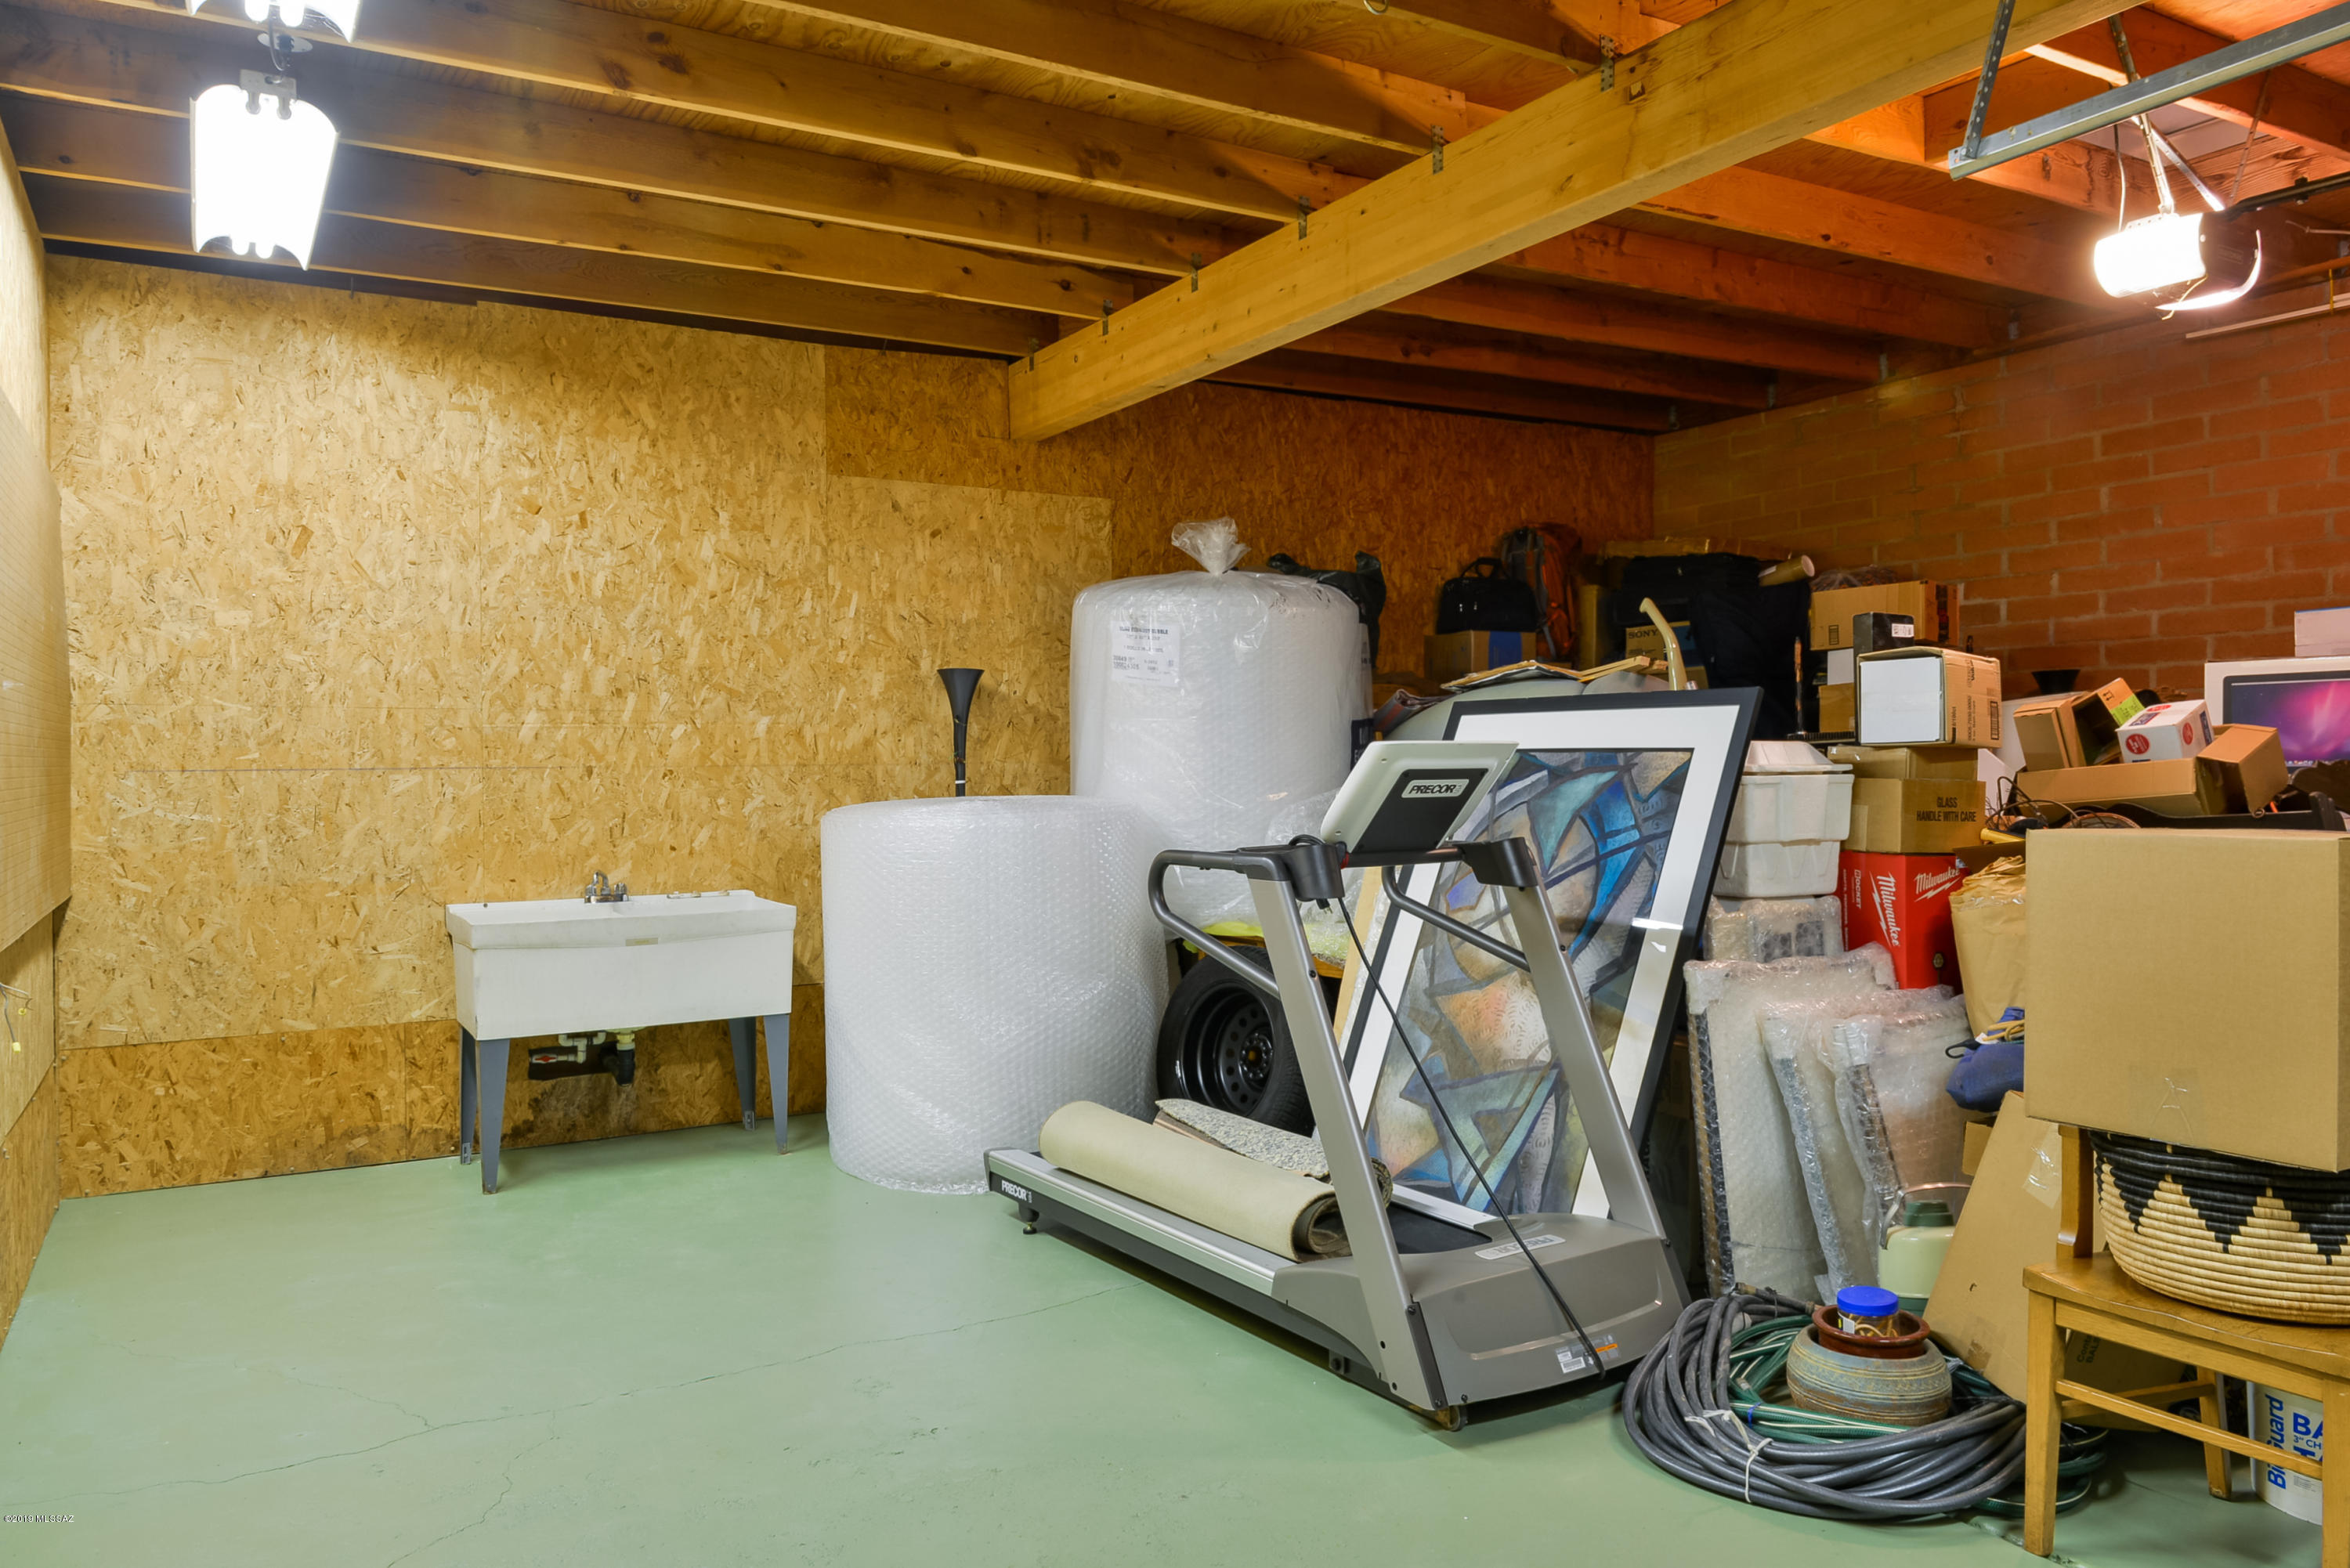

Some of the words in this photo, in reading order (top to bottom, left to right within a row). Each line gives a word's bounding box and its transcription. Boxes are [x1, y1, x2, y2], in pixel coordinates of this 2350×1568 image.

[1629, 629, 1658, 639] SONY
[1408, 784, 1457, 794] PRECOR
[1936, 797, 1958, 808] GLASS
[1917, 811, 1942, 822] HANDLE
[1943, 811, 1959, 822] WITH
[1960, 811, 1976, 822] CARE
[1914, 866, 1961, 895] Milwaukee
[1876, 870, 1901, 947] Milwaukee
[1001, 1180, 1027, 1201] PRECOR
